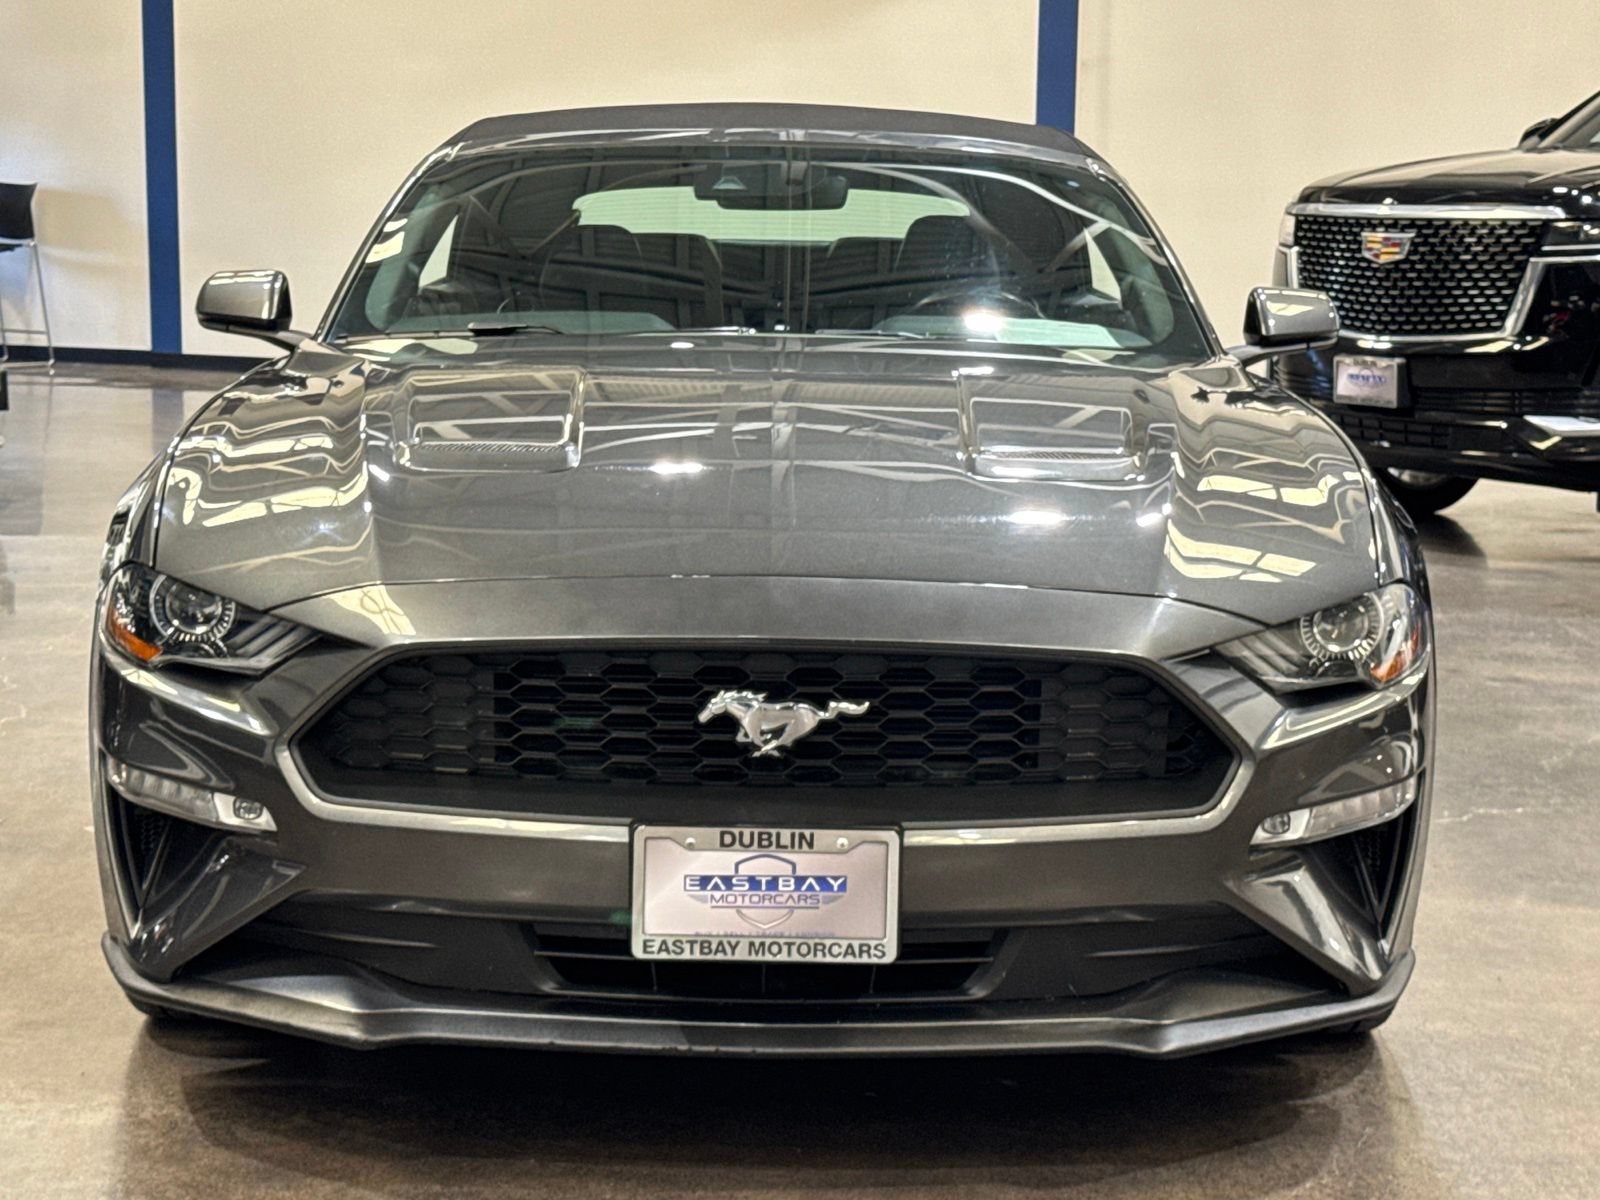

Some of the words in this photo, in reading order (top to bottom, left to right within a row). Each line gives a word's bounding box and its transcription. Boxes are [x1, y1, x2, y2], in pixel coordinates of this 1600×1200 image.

[719, 830, 815, 849] DUBLIN
[684, 876, 847, 892] EASTBAY
[709, 893, 820, 905] MOTORCARS
[642, 939, 741, 956] EASTBAY
[748, 941, 887, 960] MOTORCARS
